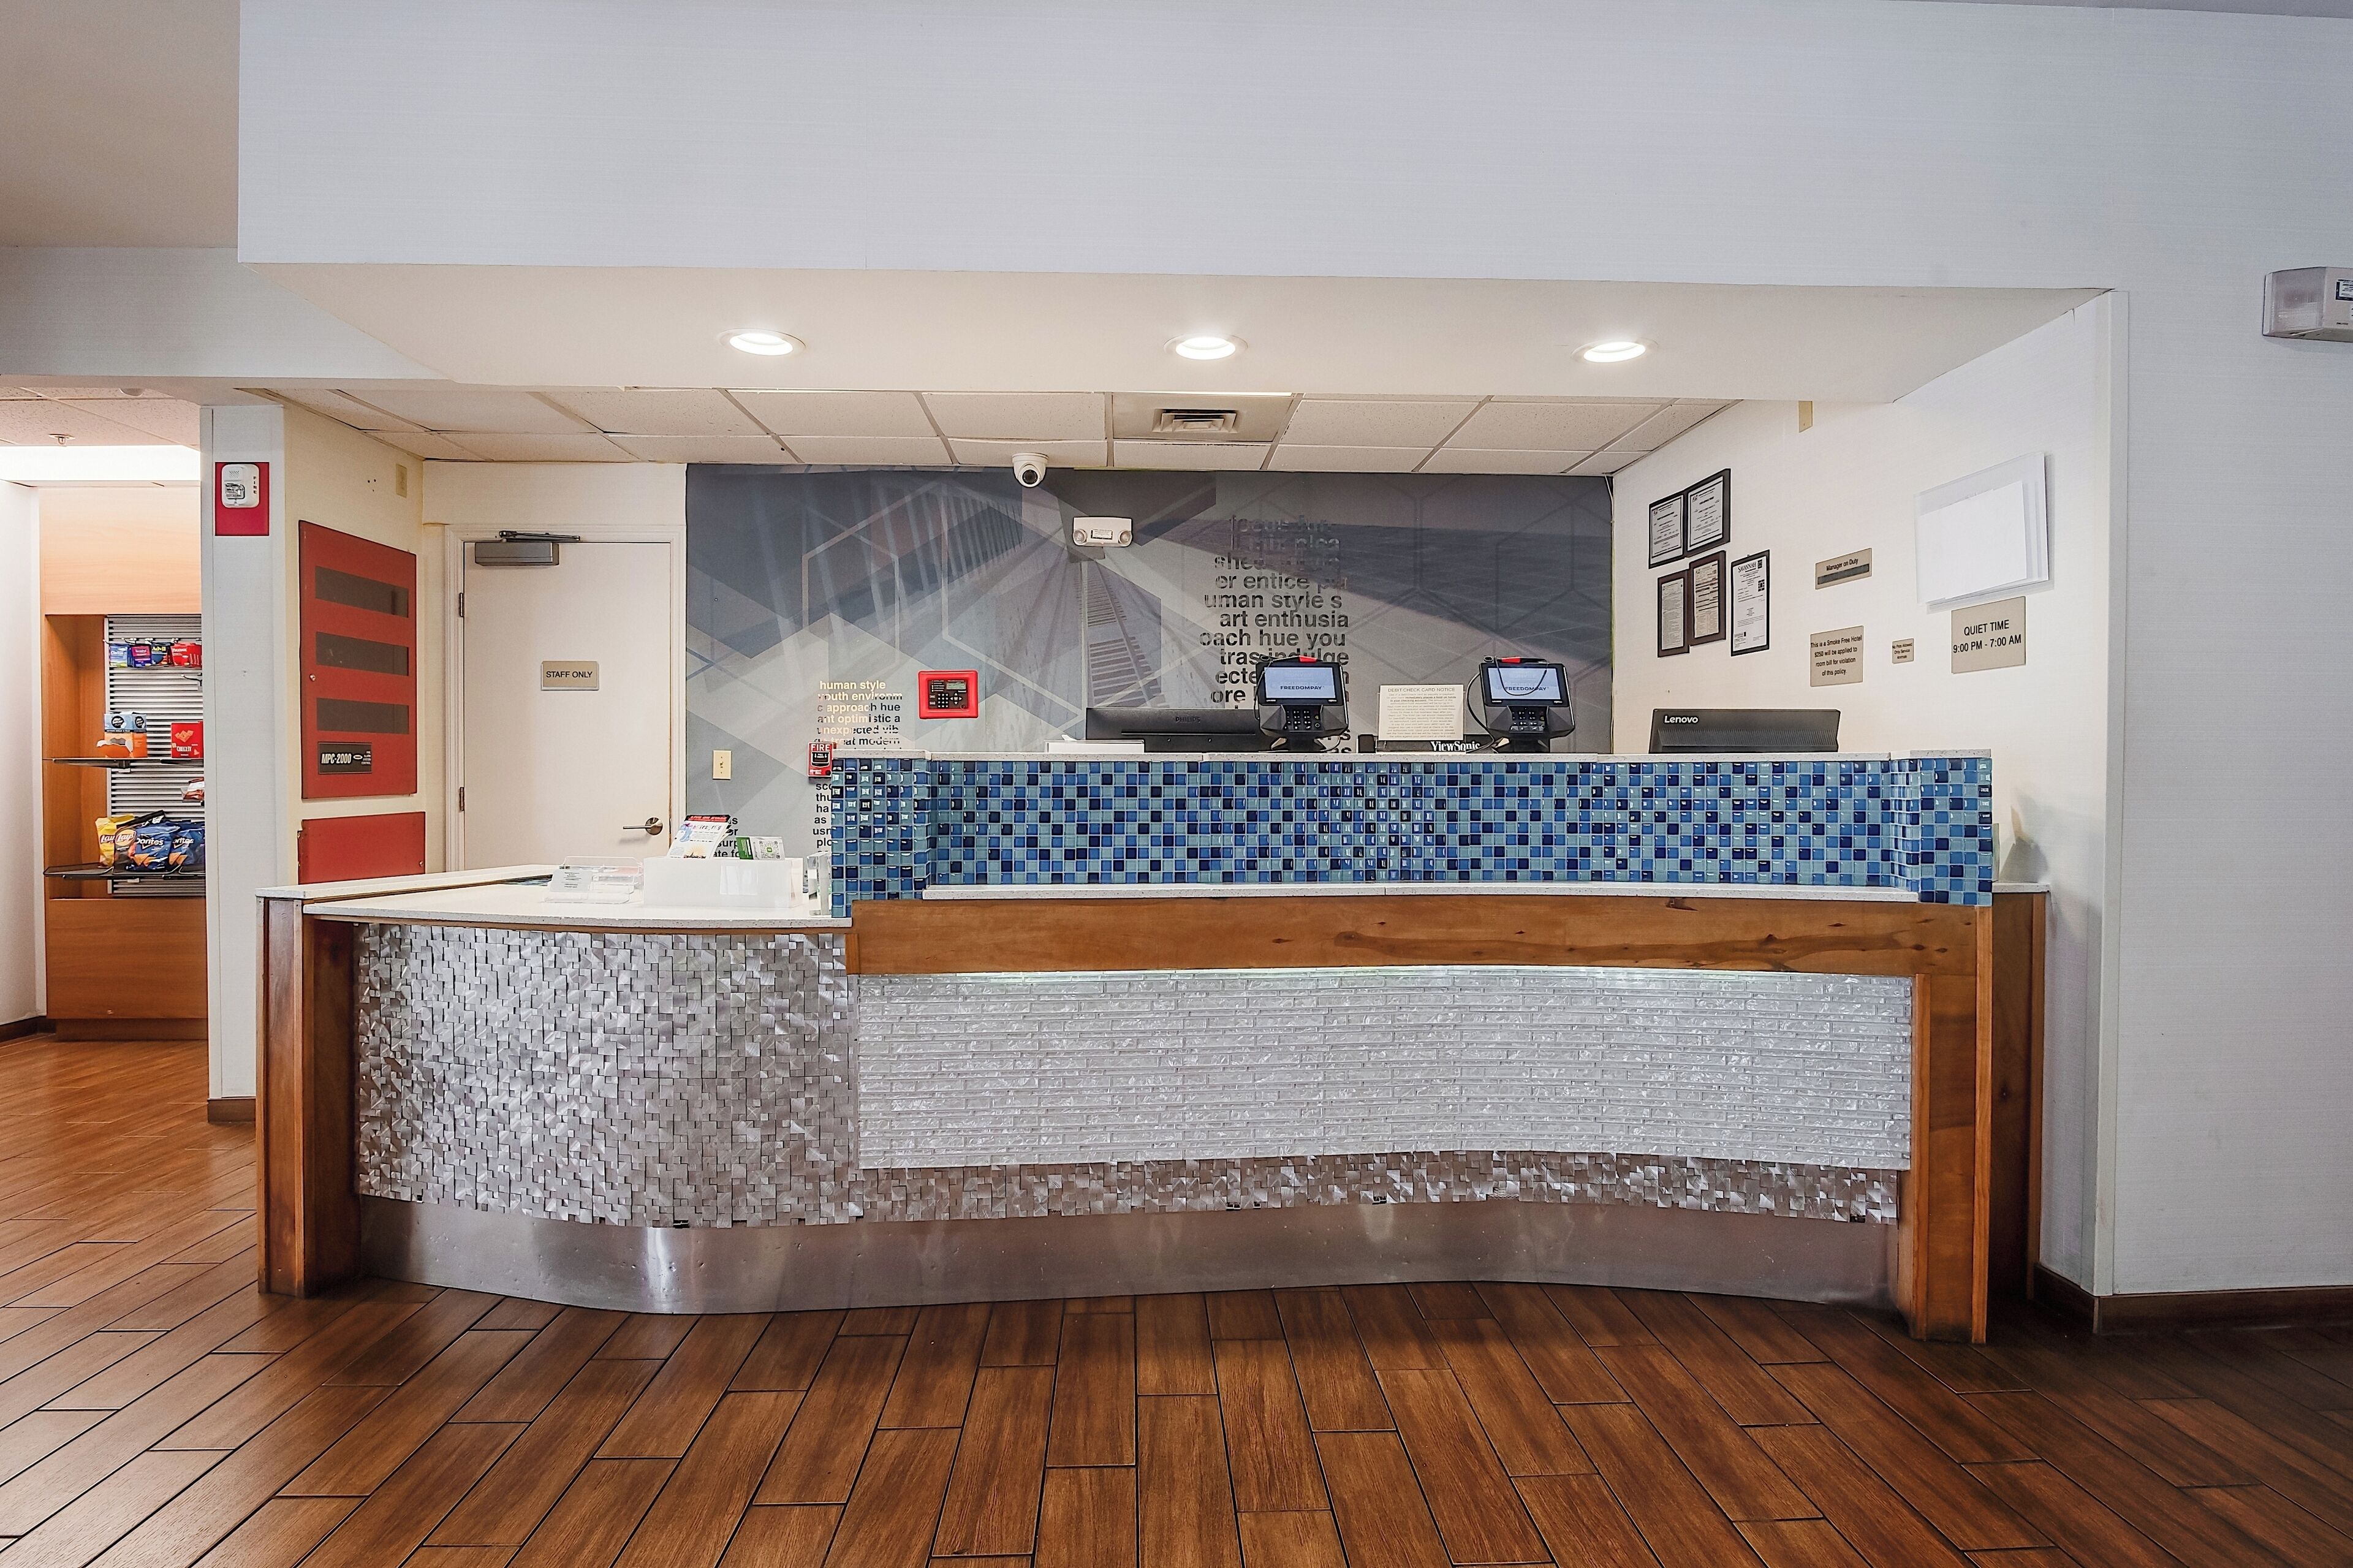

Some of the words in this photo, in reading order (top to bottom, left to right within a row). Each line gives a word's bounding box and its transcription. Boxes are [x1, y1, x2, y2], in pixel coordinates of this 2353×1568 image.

[1243, 572, 1310, 589] entice
[1204, 594, 1264, 608] uman
[1271, 591, 1324, 613] style
[1330, 594, 1342, 608] s
[1220, 610, 1248, 627] art
[1255, 610, 1349, 627] enthusia
[1964, 623, 1988, 635] QUIET
[1990, 619, 2009, 631] TIME
[1199, 629, 1251, 646] oach
[1259, 629, 1299, 646] hue
[1306, 632, 1346, 650] you
[1953, 643, 1969, 653] 9:00
[1971, 640, 1982, 650] PM
[1990, 637, 2007, 647] 7:00
[2009, 634, 2021, 645] AM
[820, 680, 857, 689] human
[860, 680, 886, 691] style
[818, 691, 849, 702] youth
[852, 691, 903, 701] environm
[827, 703, 877, 714] approach
[881, 703, 901, 711] hue
[838, 714, 891, 725] optimistic
[1431, 741, 1480, 752] ViewSonic
[321, 753, 352, 763] MPC-2000
[816, 804, 828, 812] ha
